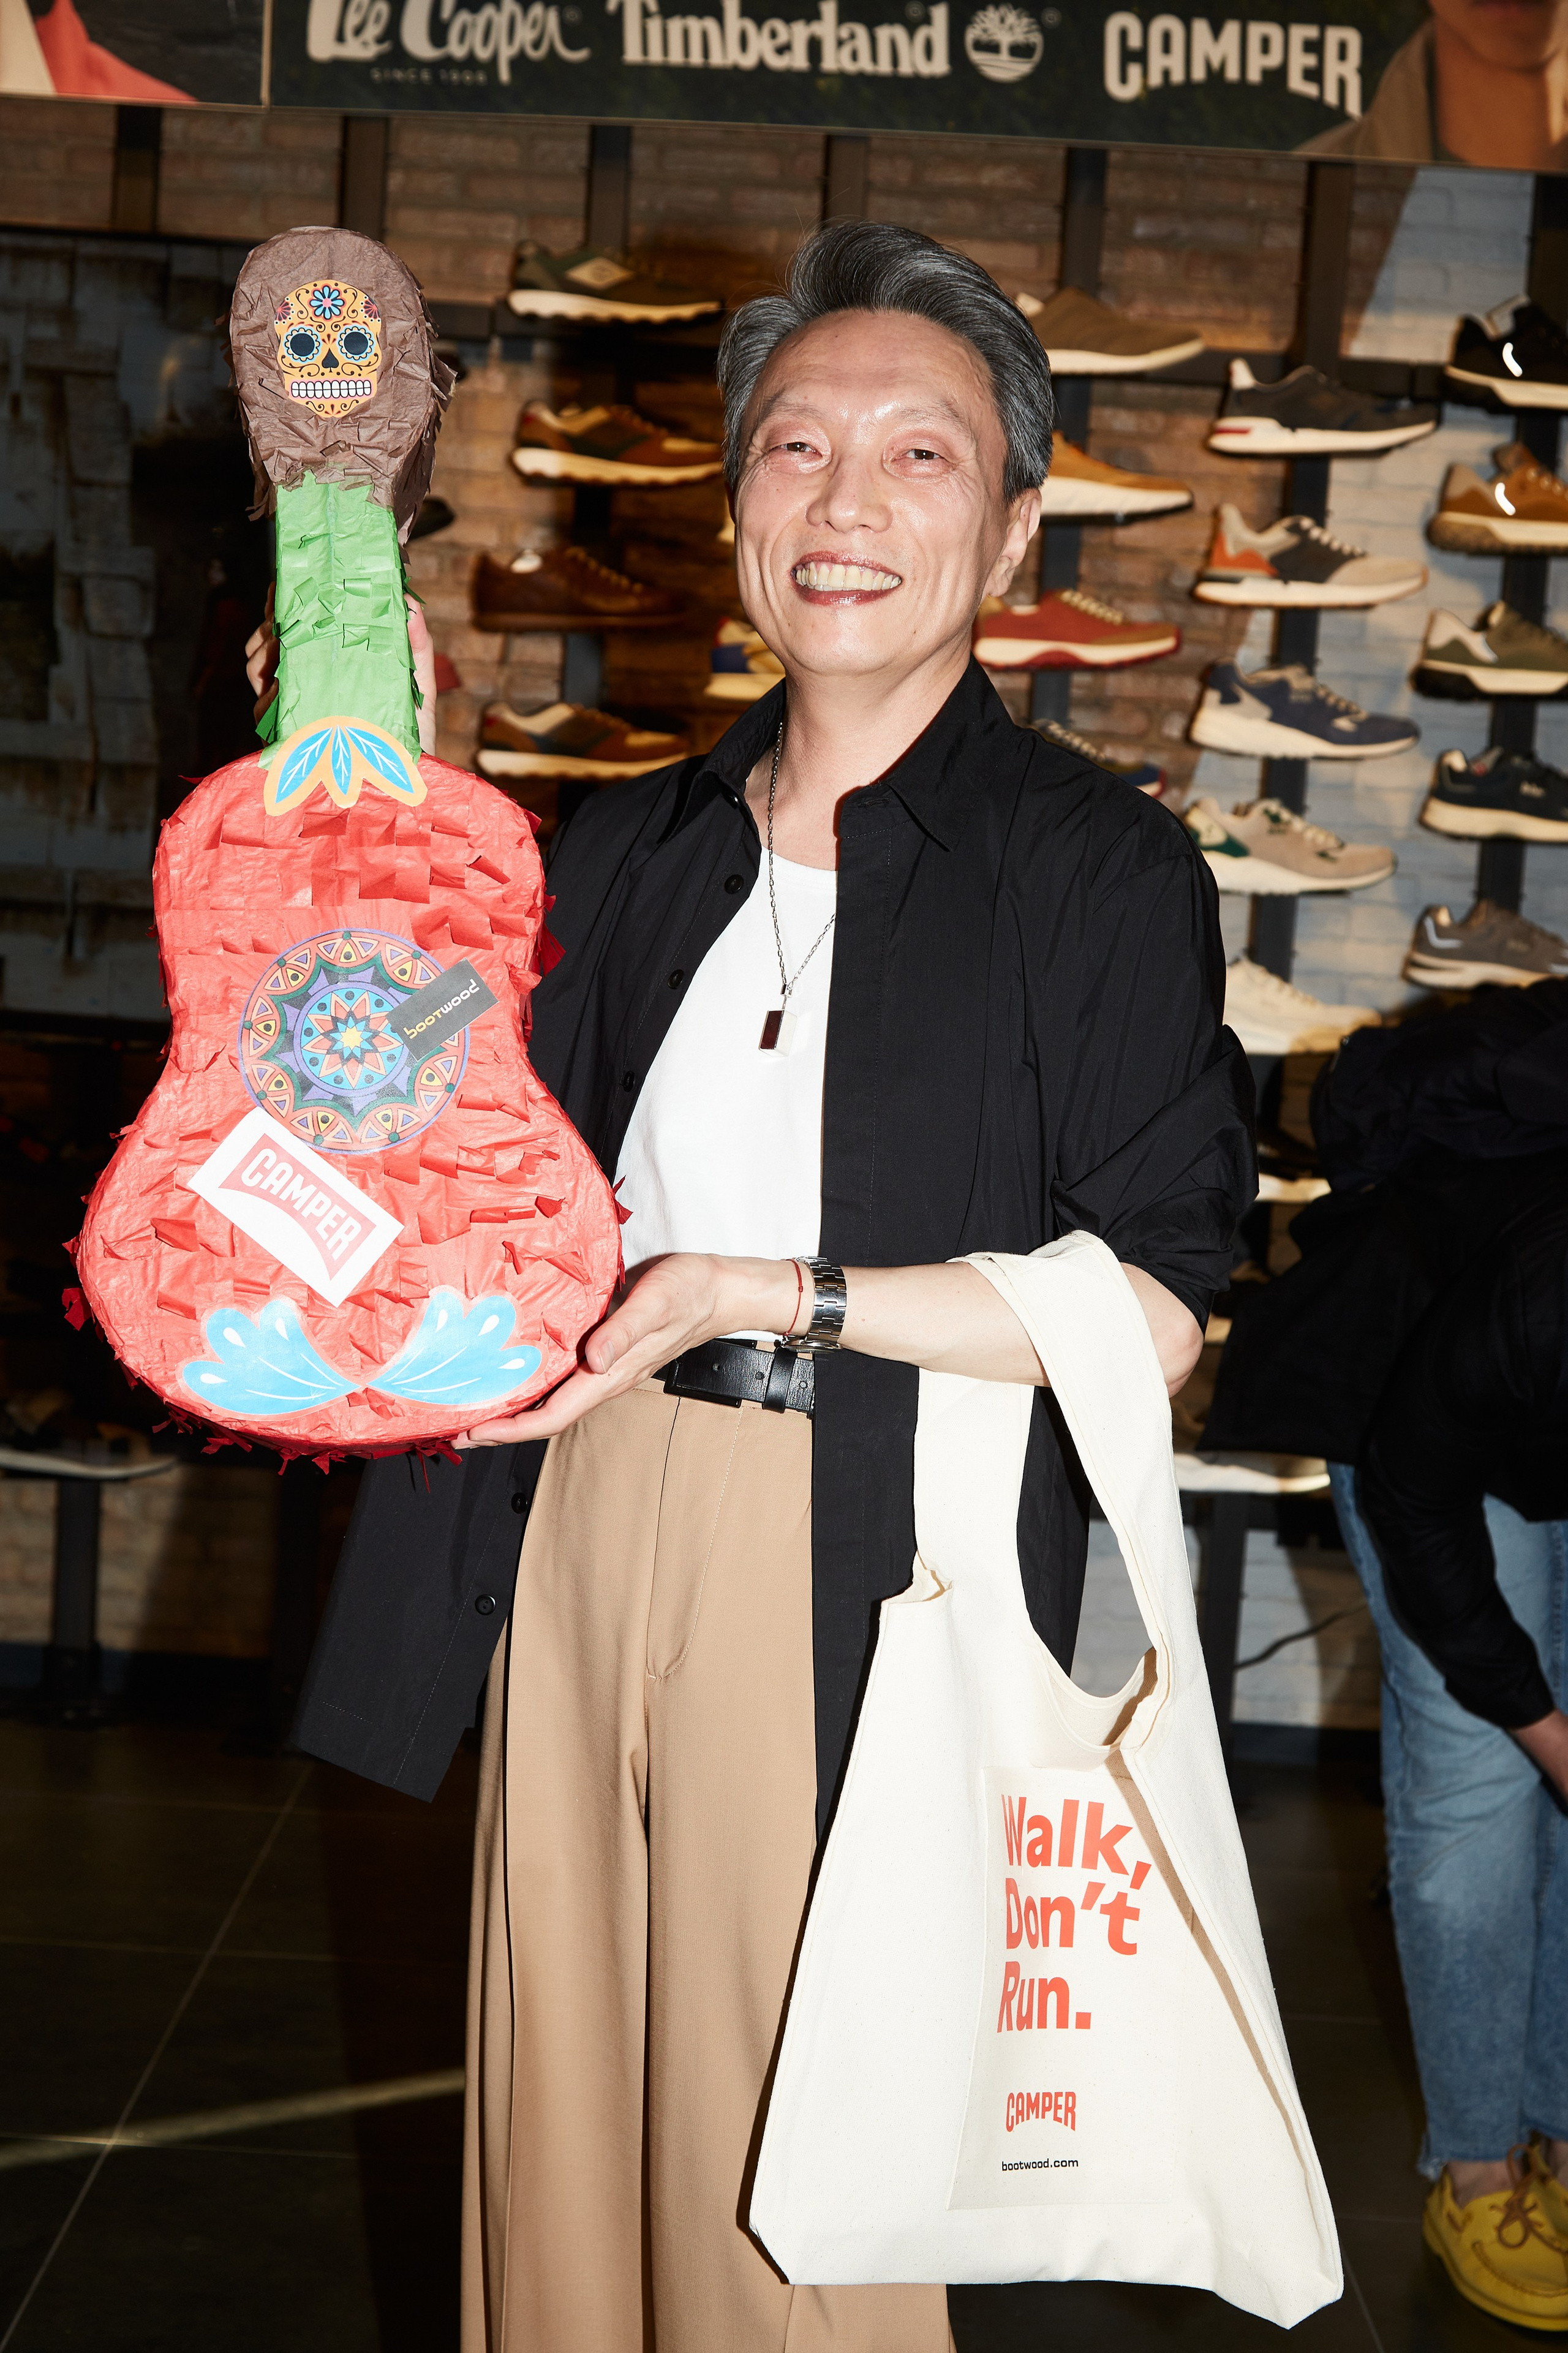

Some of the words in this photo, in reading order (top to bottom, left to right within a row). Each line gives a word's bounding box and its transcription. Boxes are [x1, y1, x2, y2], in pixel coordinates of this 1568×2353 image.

[307, 0, 393, 60] Lee
[401, 0, 592, 85] Cooper
[606, 0, 951, 77] Timberland
[1104, 11, 1363, 121] CAMPER
[241, 1148, 362, 1262] CAMPER
[1001, 1794, 1152, 1890] Walk,
[1005, 1878, 1140, 1955] Don’t
[997, 1961, 1091, 2033] Run.
[1006, 2091, 1076, 2132] CAMPER
[1001, 2158, 1079, 2171] bootwood.com
